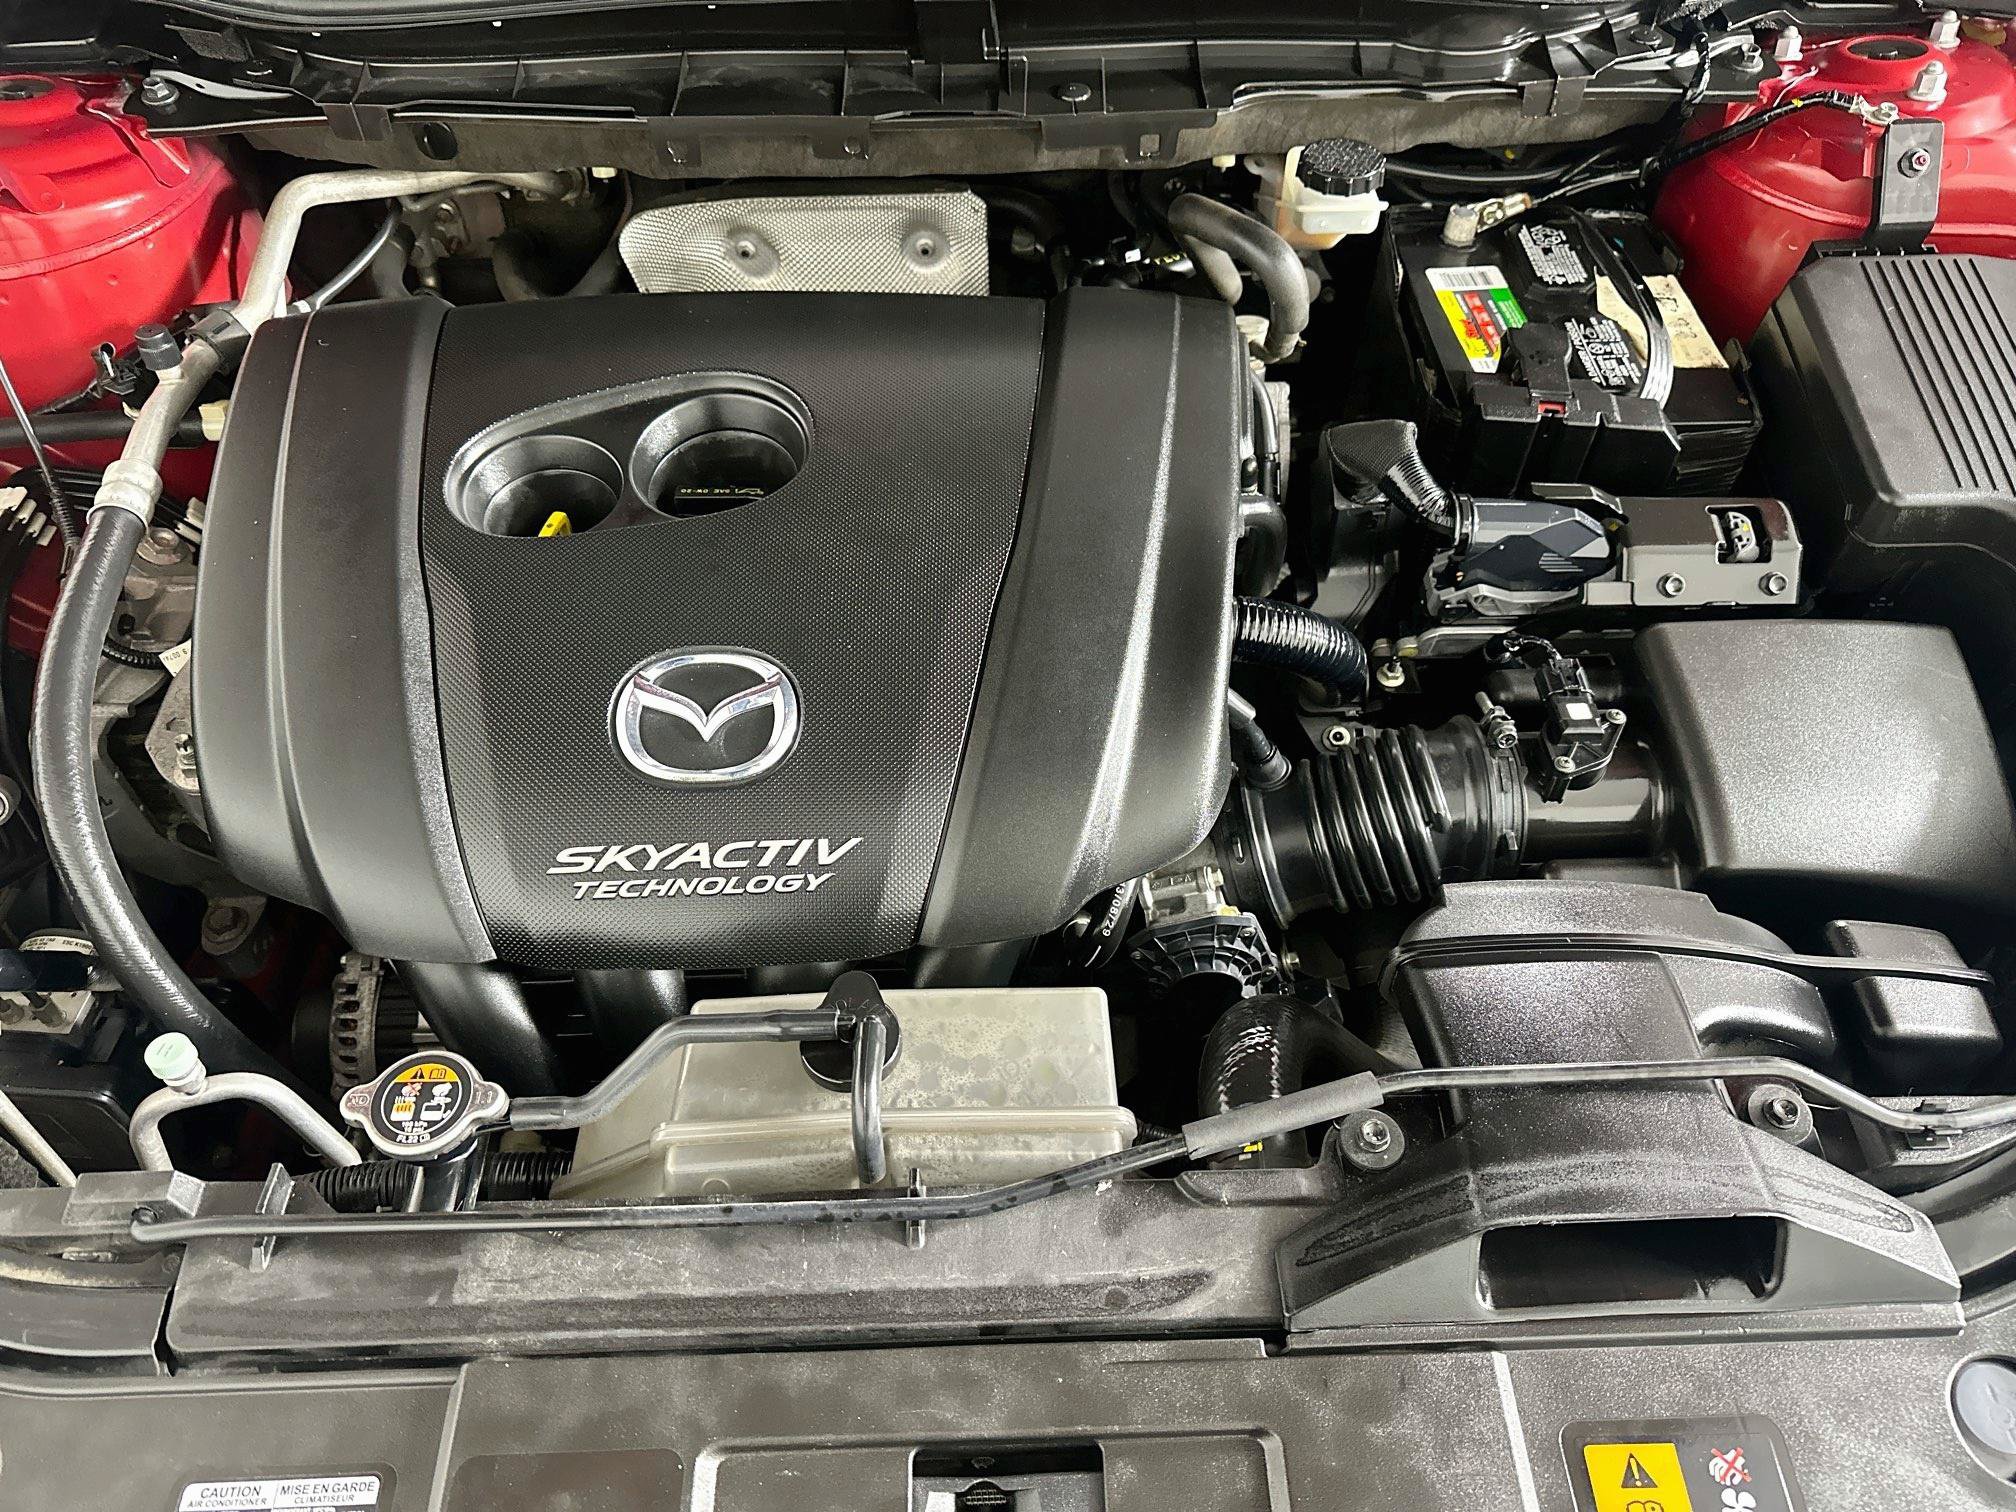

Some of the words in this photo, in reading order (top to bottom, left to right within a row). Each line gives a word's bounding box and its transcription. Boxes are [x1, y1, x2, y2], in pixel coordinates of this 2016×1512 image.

[546, 837, 864, 875] SKYACTIV
[573, 873, 836, 900] TECHNOLOGY
[200, 1485, 261, 1499] CAUTION
[280, 1484, 310, 1496] MISE
[313, 1483, 330, 1494] EN
[332, 1481, 376, 1493] GARDE
[187, 1500, 204, 1508] AIR
[205, 1498, 268, 1507] CONDITIONER
[294, 1495, 355, 1504] CLIMATISEUR
